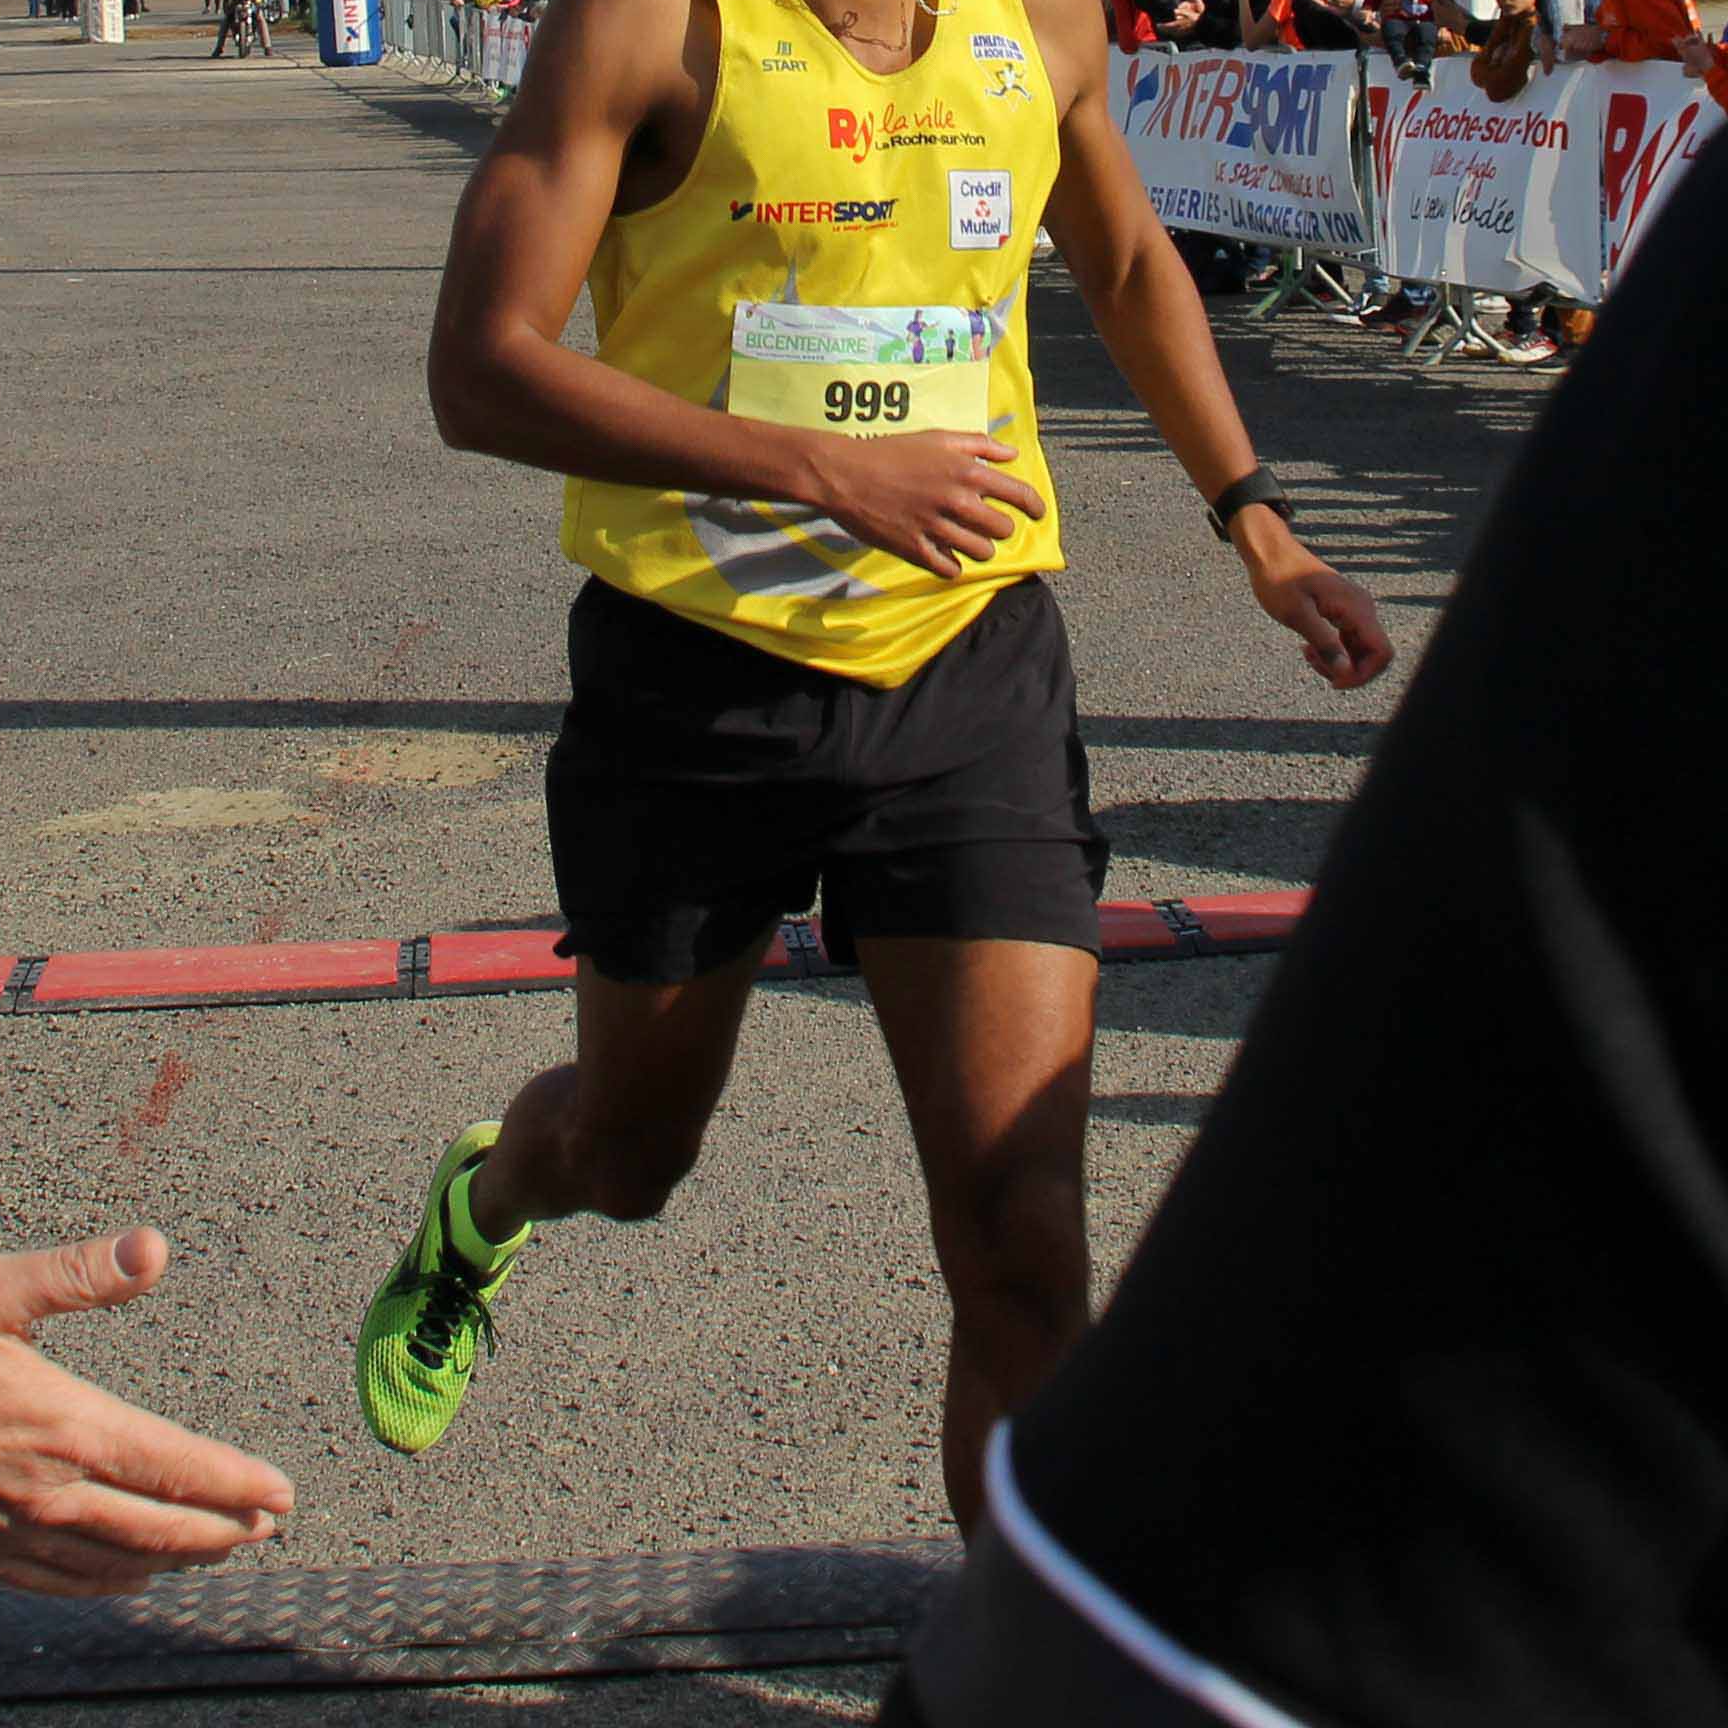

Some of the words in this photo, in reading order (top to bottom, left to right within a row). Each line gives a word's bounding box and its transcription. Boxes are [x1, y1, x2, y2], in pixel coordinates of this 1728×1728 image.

[762, 58, 808, 73] START
[878, 102, 908, 134] la
[914, 98, 955, 129] ville
[1424, 107, 1568, 150] Roche-sur-Yon
[891, 133, 985, 147] Roche-sur-Yon
[960, 179, 1002, 197] Crédit
[757, 199, 896, 222] INTERSPORT
[960, 218, 1001, 235] Mutuel
[1325, 212, 1364, 243] YON
[745, 331, 867, 353] BICENTENAIRE
[825, 381, 910, 422] 999
